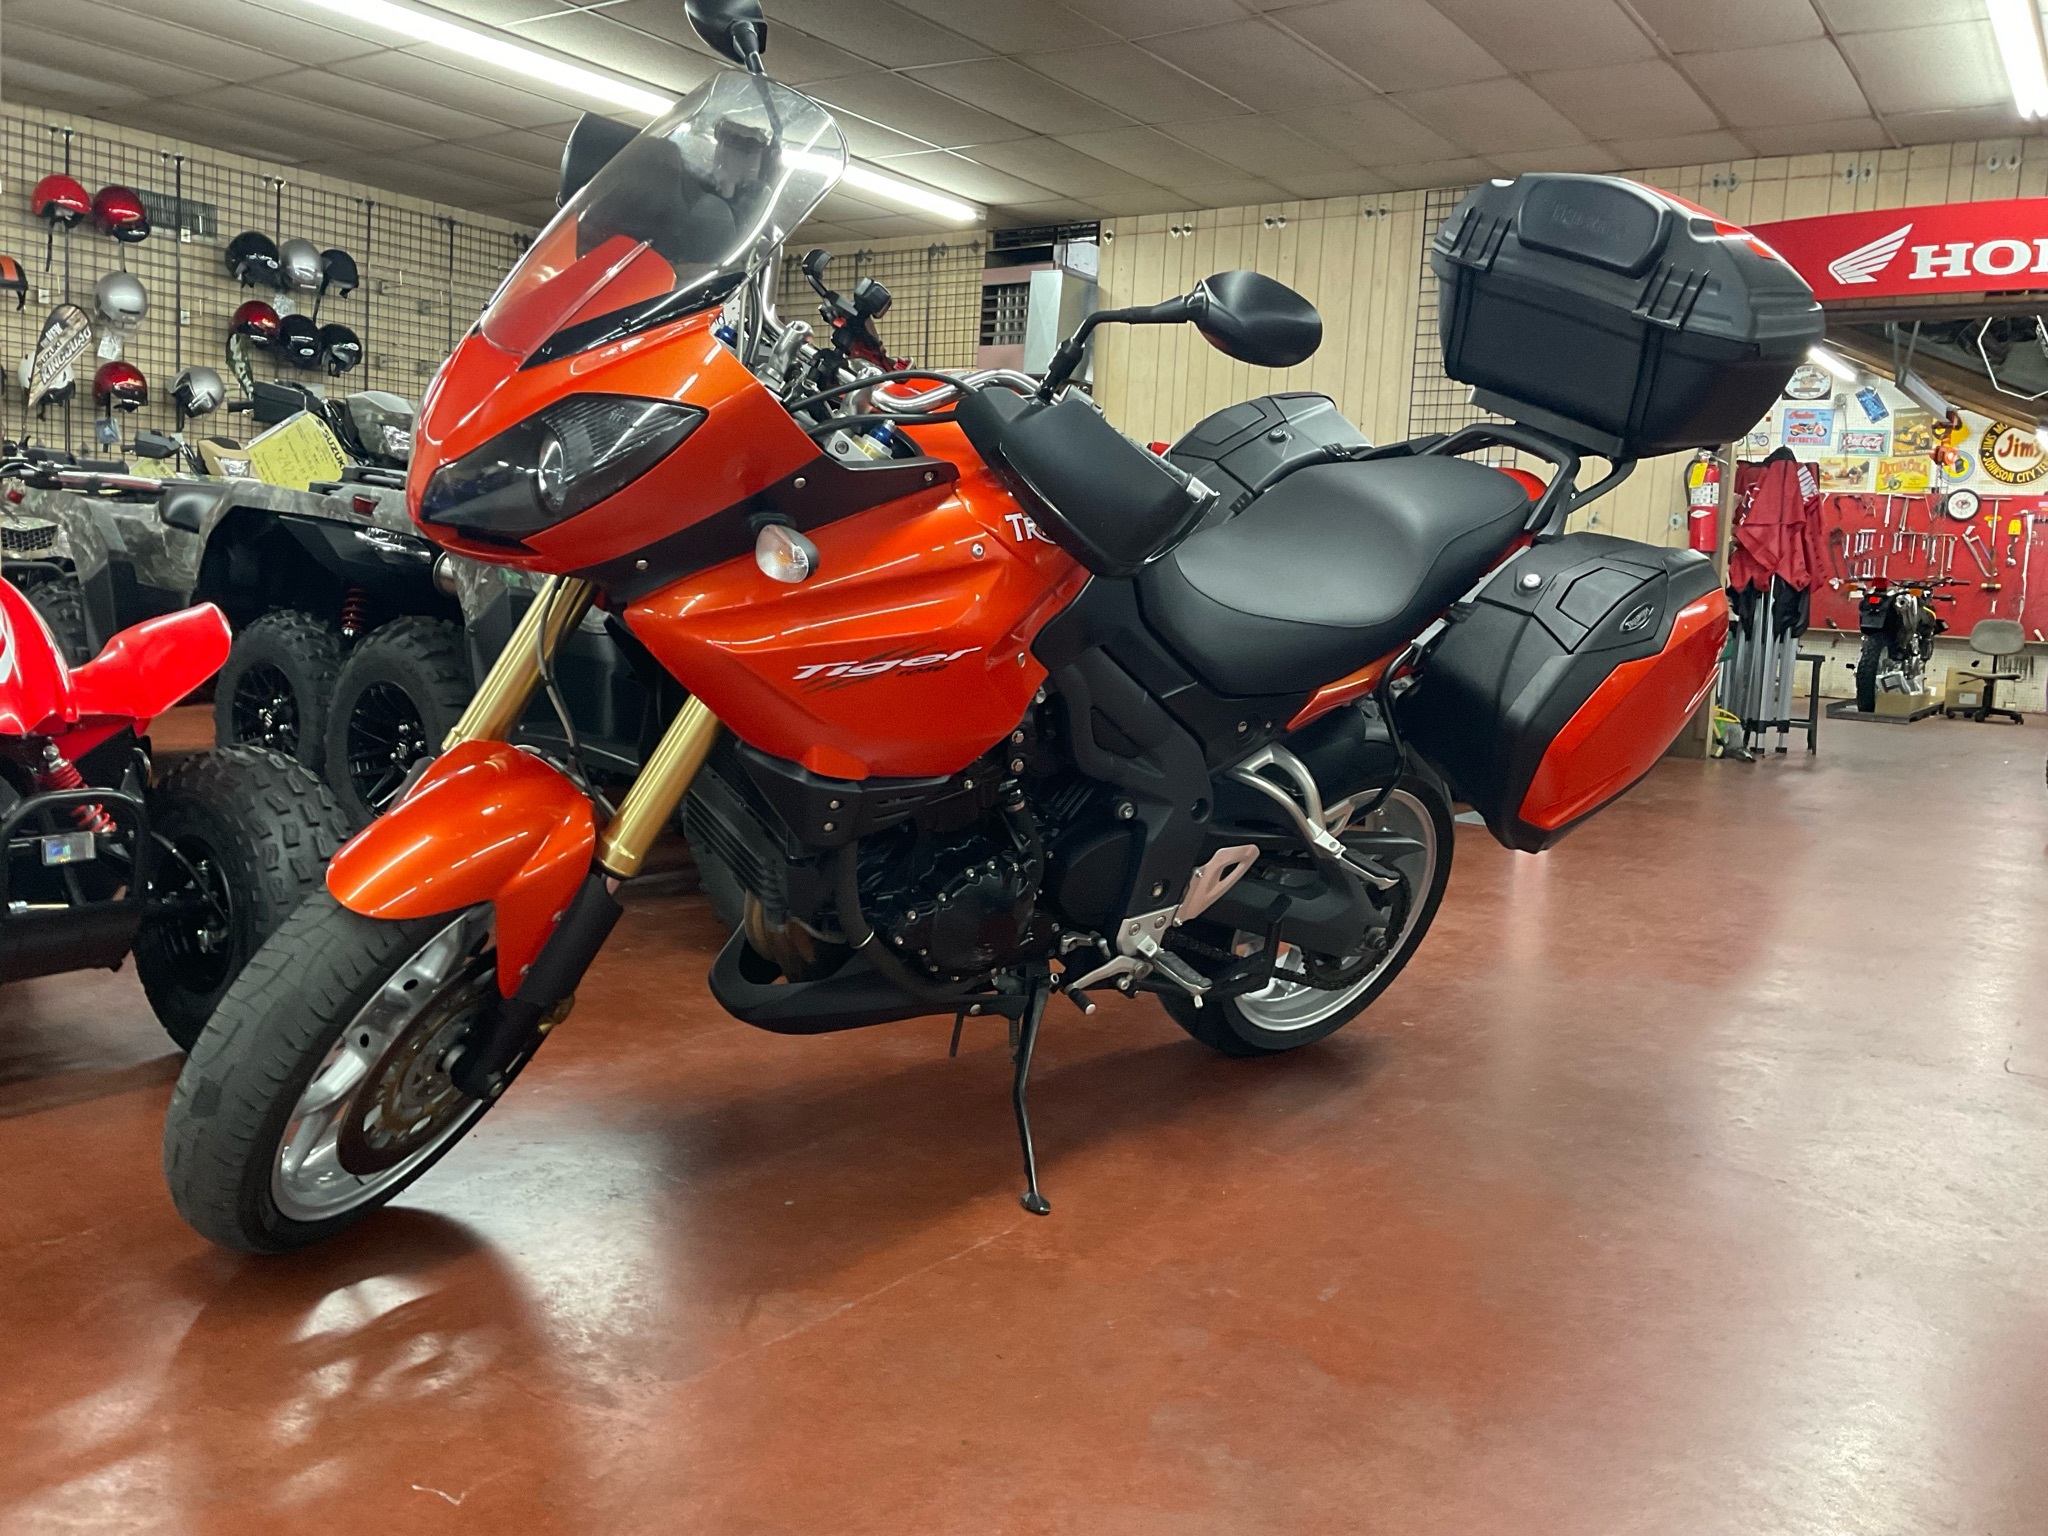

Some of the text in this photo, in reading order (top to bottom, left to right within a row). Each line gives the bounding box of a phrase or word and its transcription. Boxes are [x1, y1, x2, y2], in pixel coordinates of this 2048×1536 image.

[1909, 239, 2048, 280] HO
[45, 322, 63, 341] NEW
[36, 341, 62, 368] SUZUKI
[40, 326, 92, 385] KINGQUAD
[321, 429, 346, 471] SUZUK
[1983, 457, 2015, 482] JOHNSON
[1004, 512, 1057, 545] TR
[793, 646, 983, 680] Tiger
